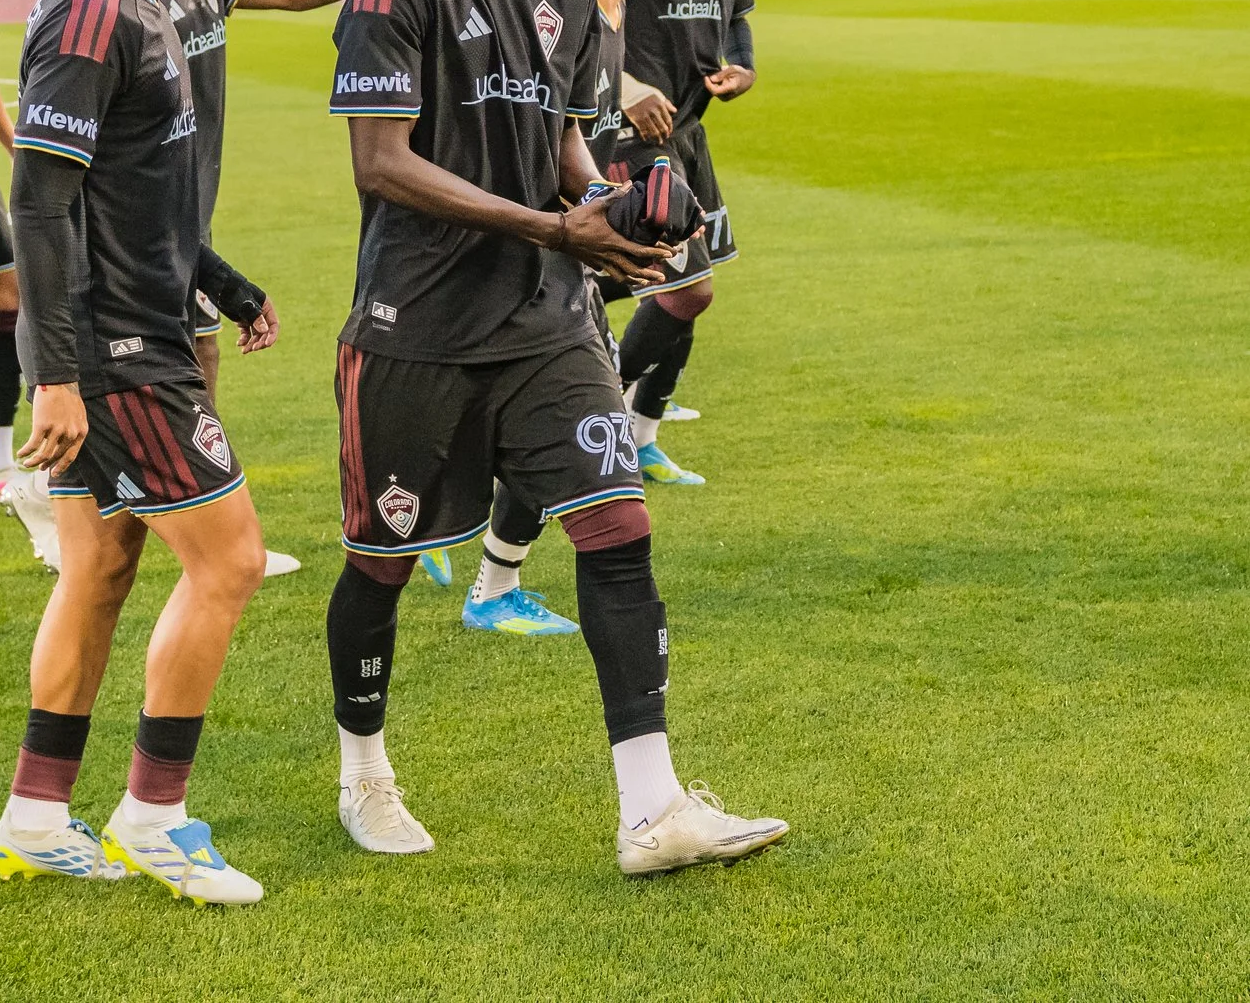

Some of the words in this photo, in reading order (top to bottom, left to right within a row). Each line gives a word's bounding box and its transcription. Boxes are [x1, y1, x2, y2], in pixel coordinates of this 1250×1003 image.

[336, 71, 412, 94] Kiewit
[26, 104, 98, 141] Kiewit
[576, 412, 640, 476] 93
